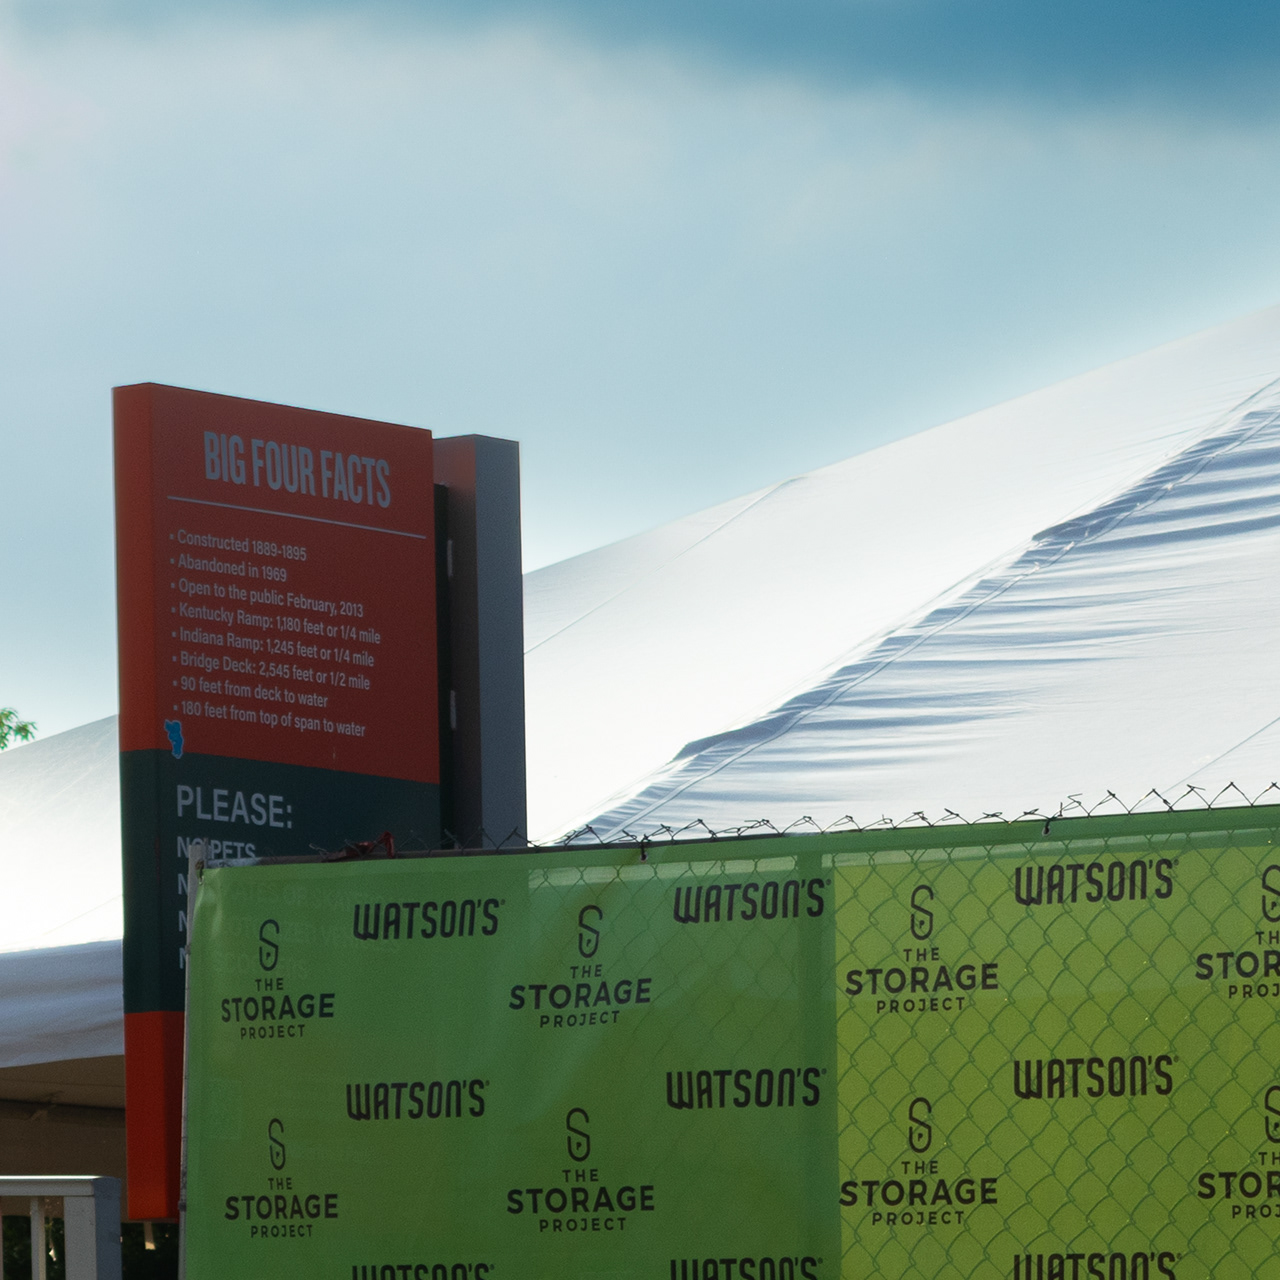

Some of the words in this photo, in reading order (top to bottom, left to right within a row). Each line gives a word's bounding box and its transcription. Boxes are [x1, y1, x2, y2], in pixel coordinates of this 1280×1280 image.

[204, 431, 246, 484] BIG
[252, 439, 316, 496] FOUR
[320, 450, 391, 508] FACTS
[176, 529, 250, 552] Constructed
[251, 540, 308, 561] 1889-1895
[177, 554, 247, 576] Abandoned
[247, 563, 260, 577] in
[261, 566, 288, 582] 1969
[178, 578, 212, 596] Open
[212, 583, 227, 597] to
[227, 585, 248, 600] the
[249, 589, 285, 605] public
[286, 592, 338, 616] February,
[339, 601, 364, 617] 2013
[178, 602, 235, 626] Kentucky
[236, 610, 274, 630] Ramp:
[275, 616, 302, 632] 1,180
[302, 618, 325, 635] feet
[326, 626, 339, 637] or
[339, 625, 358, 640] 1/4
[358, 628, 382, 644] mile
[179, 627, 225, 645] Indiana
[226, 633, 264, 653] Ramp:
[266, 639, 295, 655] 1,245
[296, 642, 319, 658] feet
[319, 649, 333, 660] or
[333, 648, 351, 662] 1/4
[352, 651, 375, 667] mile
[180, 651, 221, 672] Bridge
[222, 656, 257, 674] Deck:
[258, 661, 291, 678] 2,545
[291, 666, 315, 681] feet
[315, 672, 328, 683] or
[329, 672, 347, 686] 1/2
[347, 674, 371, 690] mile
[180, 676, 197, 691] 90
[198, 677, 223, 694] feet
[223, 680, 252, 697] from
[253, 685, 282, 701] deck
[283, 689, 296, 703] to
[297, 693, 329, 707] water
[180, 701, 203, 716] 180
[203, 702, 228, 719] feet
[229, 705, 258, 722] from
[258, 710, 279, 728] top
[279, 713, 293, 727] of
[293, 717, 322, 732] span
[322, 718, 336, 732] to
[335, 722, 367, 736] water
[177, 784, 293, 829] PLEASE:
[1014, 857, 1174, 907] WATSON'S
[673, 877, 825, 924] WATSON'S
[353, 898, 500, 941] WATSON'S
[903, 946, 940, 962] THE
[254, 977, 284, 992] THE
[569, 963, 603, 980] THE
[845, 962, 999, 997] STORAGE
[221, 993, 336, 1023] STORAGE
[508, 977, 652, 1010] STORAGE
[876, 996, 965, 1014] PROJECT
[240, 1023, 306, 1040] PROJECT
[539, 1009, 620, 1029] PROJECT
[666, 1067, 821, 1110] WATSON'S
[1013, 1054, 1173, 1100] WATSON'S
[346, 1078, 485, 1121] WATSON'S
[562, 1168, 599, 1183] THE
[901, 1159, 939, 1175] THE
[267, 1176, 293, 1191] THE
[838, 1177, 998, 1207] STORAGE
[224, 1193, 339, 1221] STORAGE
[507, 1185, 655, 1215] STORAGE
[250, 1223, 313, 1238] PROJECT
[539, 1216, 627, 1233] PROJECT
[871, 1210, 965, 1226] PROJECT
